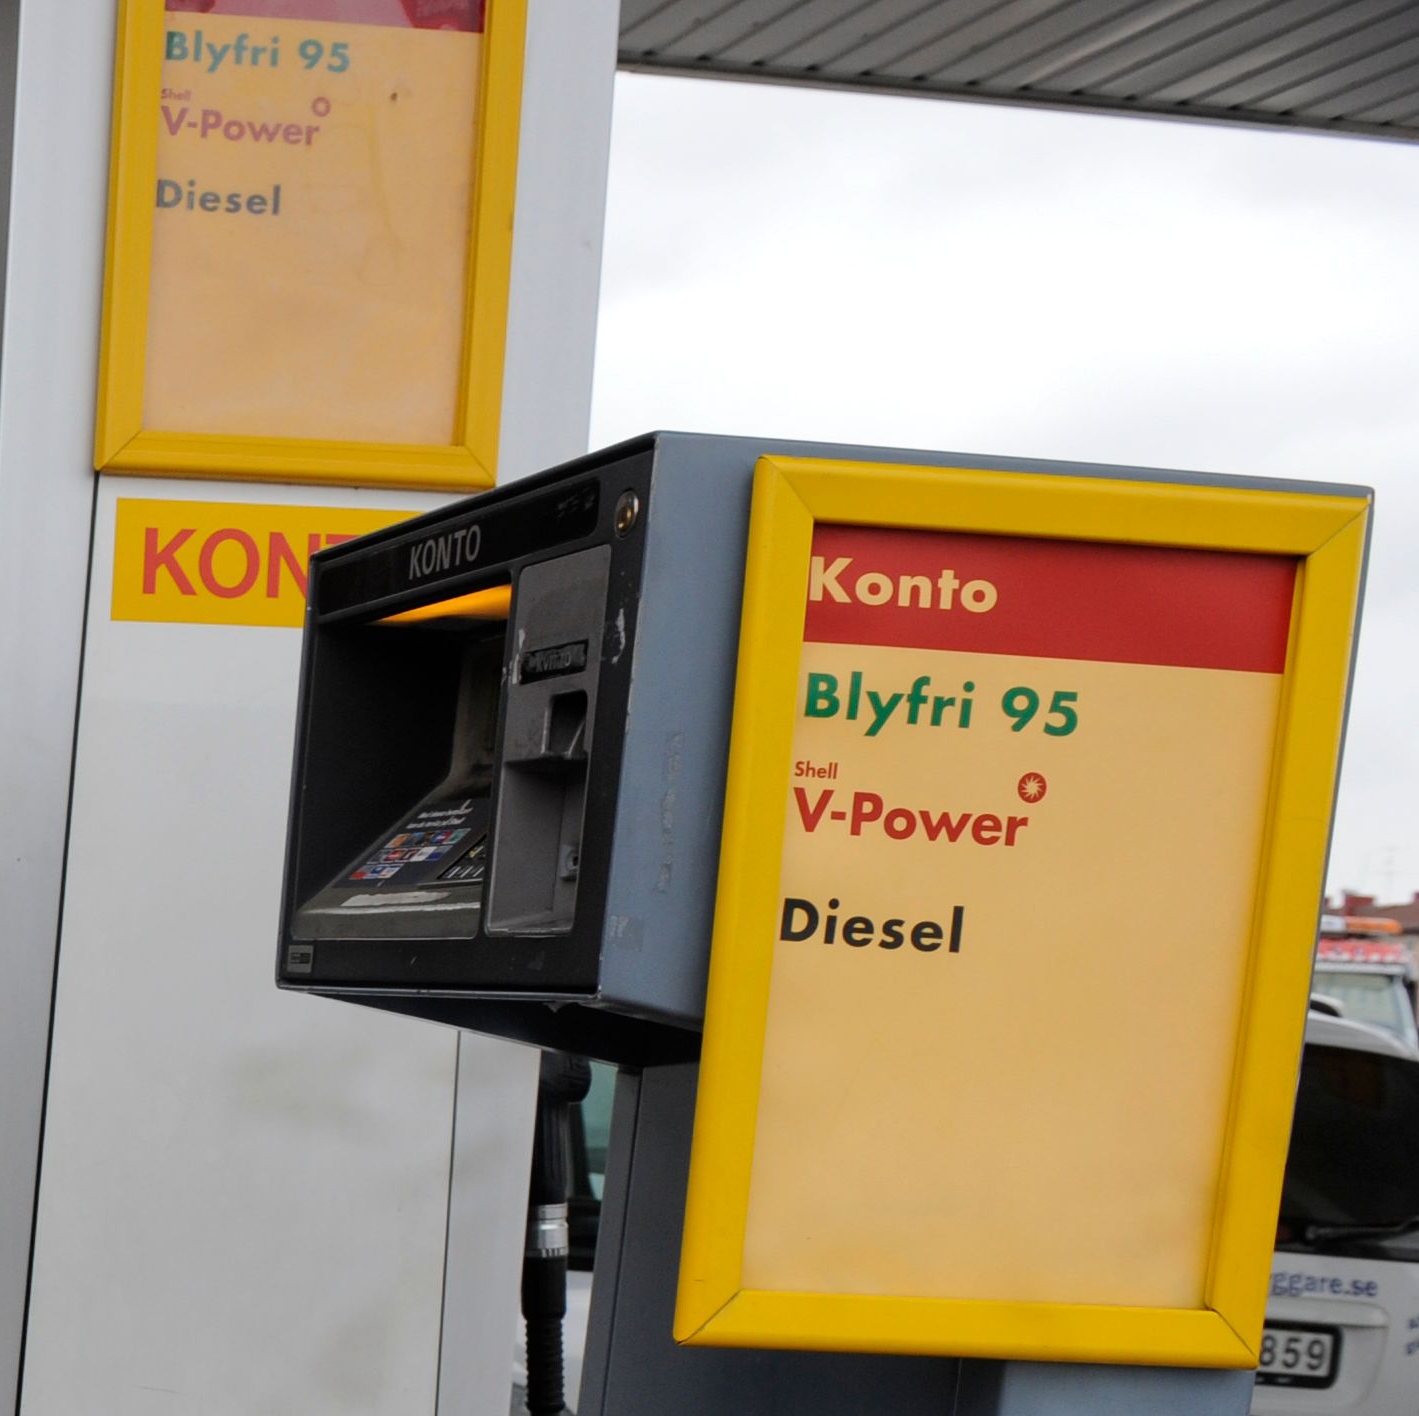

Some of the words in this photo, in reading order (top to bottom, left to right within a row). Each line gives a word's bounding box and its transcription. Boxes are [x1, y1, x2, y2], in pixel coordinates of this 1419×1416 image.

[164, 30, 280, 73] Blyfri
[298, 38, 351, 73] 95
[160, 87, 191, 101] Shell
[160, 104, 321, 147] V-Power
[155, 178, 282, 216] Diesel
[142, 526, 364, 600] KON
[408, 524, 482, 580] KONTO
[808, 555, 998, 614] Konto
[803, 671, 976, 737] Blyfri
[1000, 686, 1080, 737] 95
[794, 761, 839, 780] Shell
[793, 786, 1030, 847] V-Power
[779, 898, 965, 953] Diesel
[1270, 1272, 1379, 1297] ggare.se
[1259, 1335, 1325, 1371] 859
